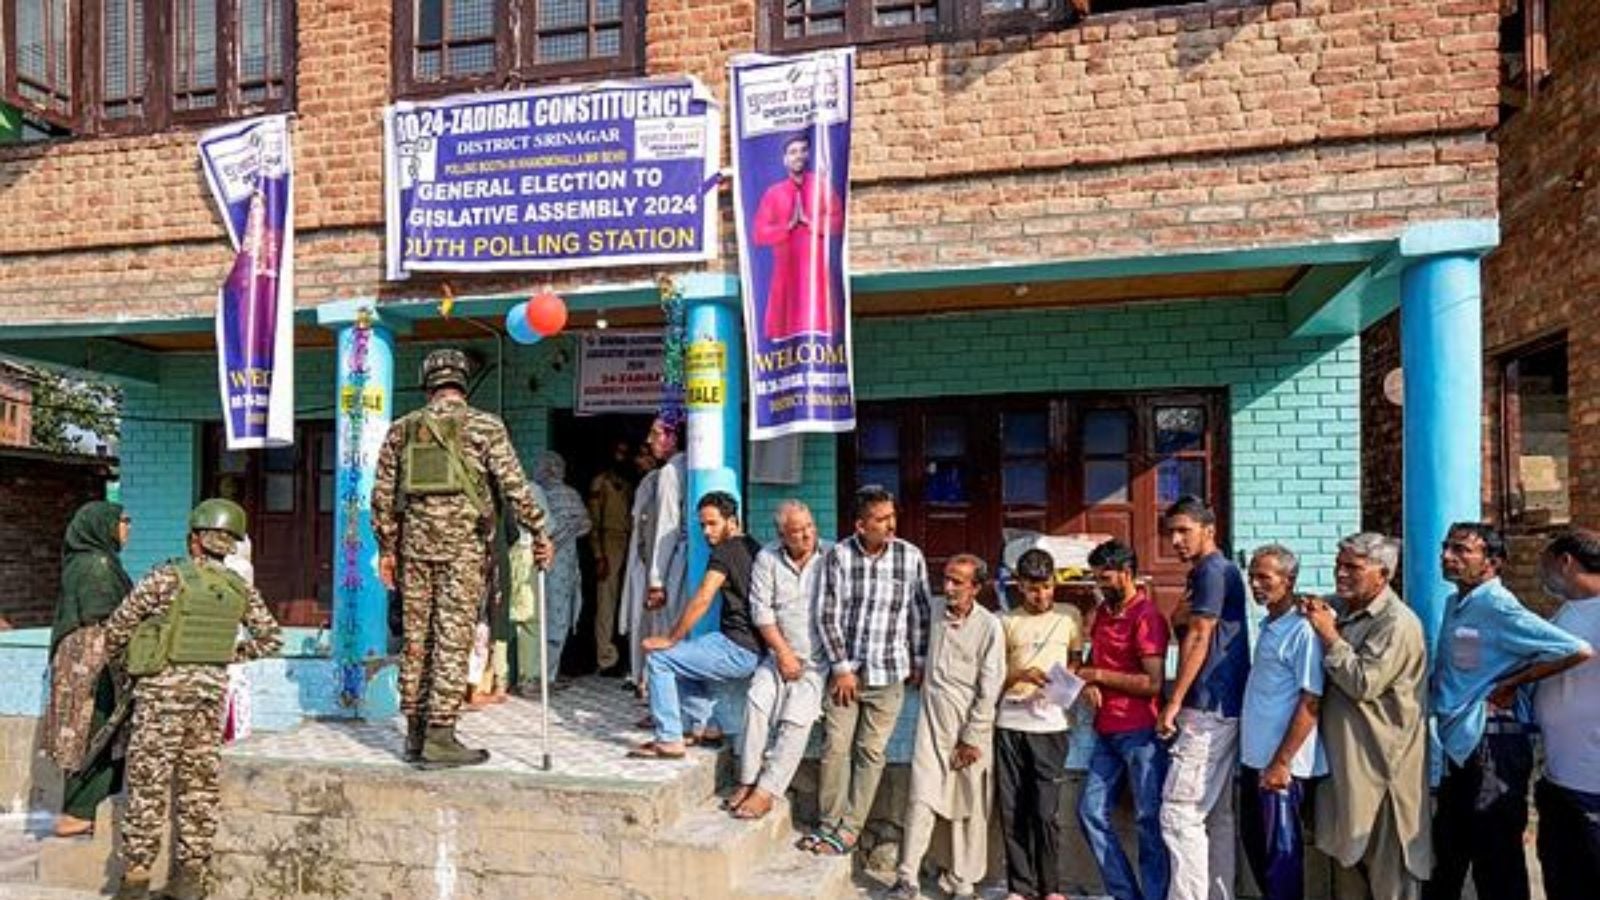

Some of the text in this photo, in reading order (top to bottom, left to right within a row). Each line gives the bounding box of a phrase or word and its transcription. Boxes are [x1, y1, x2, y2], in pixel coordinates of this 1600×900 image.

[535, 89, 692, 126] CONSTITUENCY
[457, 136, 531, 155] DISTRICT
[533, 128, 620, 148] SRINAGAR
[418, 167, 663, 202] GENERAL ELECTION TO
[410, 194, 698, 228] GISLATIVE ASSEMBLY 2024
[473, 232, 580, 257] POLLING
[588, 226, 694, 251] STATION
